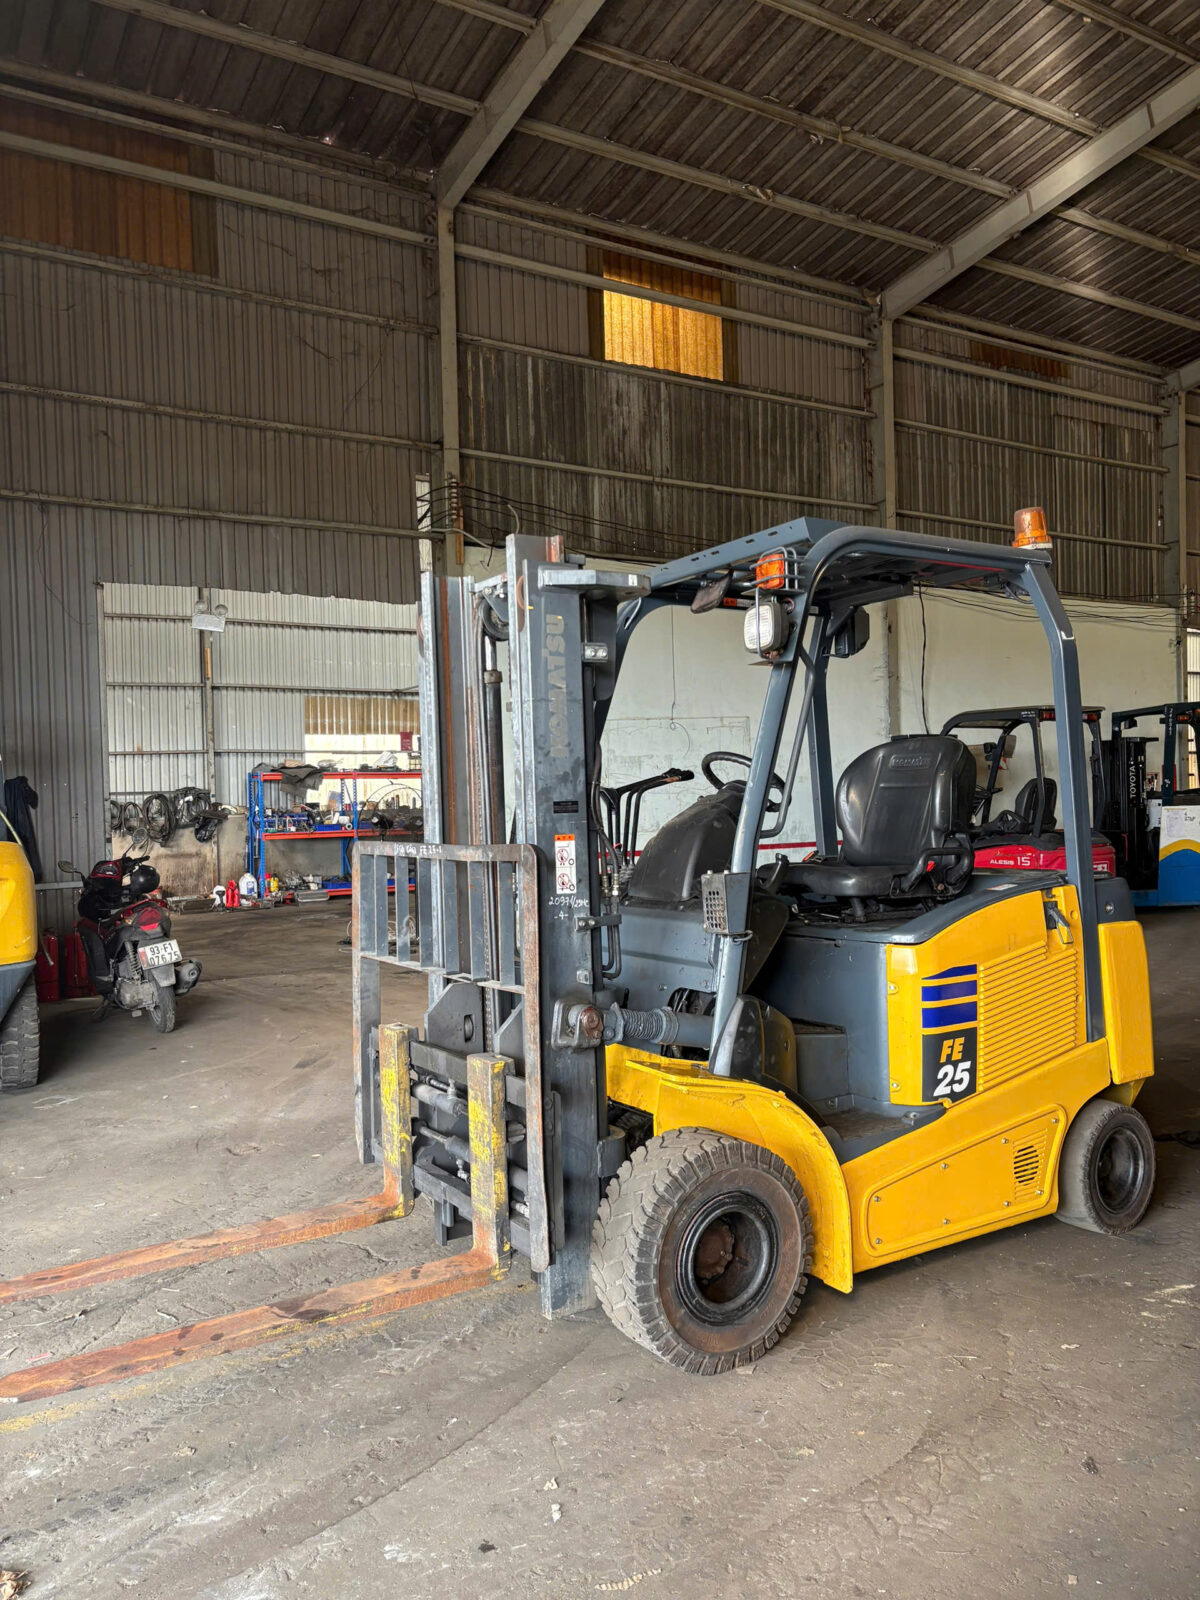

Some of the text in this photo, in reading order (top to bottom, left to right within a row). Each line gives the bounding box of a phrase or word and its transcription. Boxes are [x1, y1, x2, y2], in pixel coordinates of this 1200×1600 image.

[541, 614, 568, 758] KOMATSU
[1129, 765, 1137, 798] TOYOTA
[1017, 856, 1031, 867] 15
[150, 942, 174, 956] 93-F1
[939, 1037, 965, 1063] FE
[933, 1060, 972, 1097] 25
